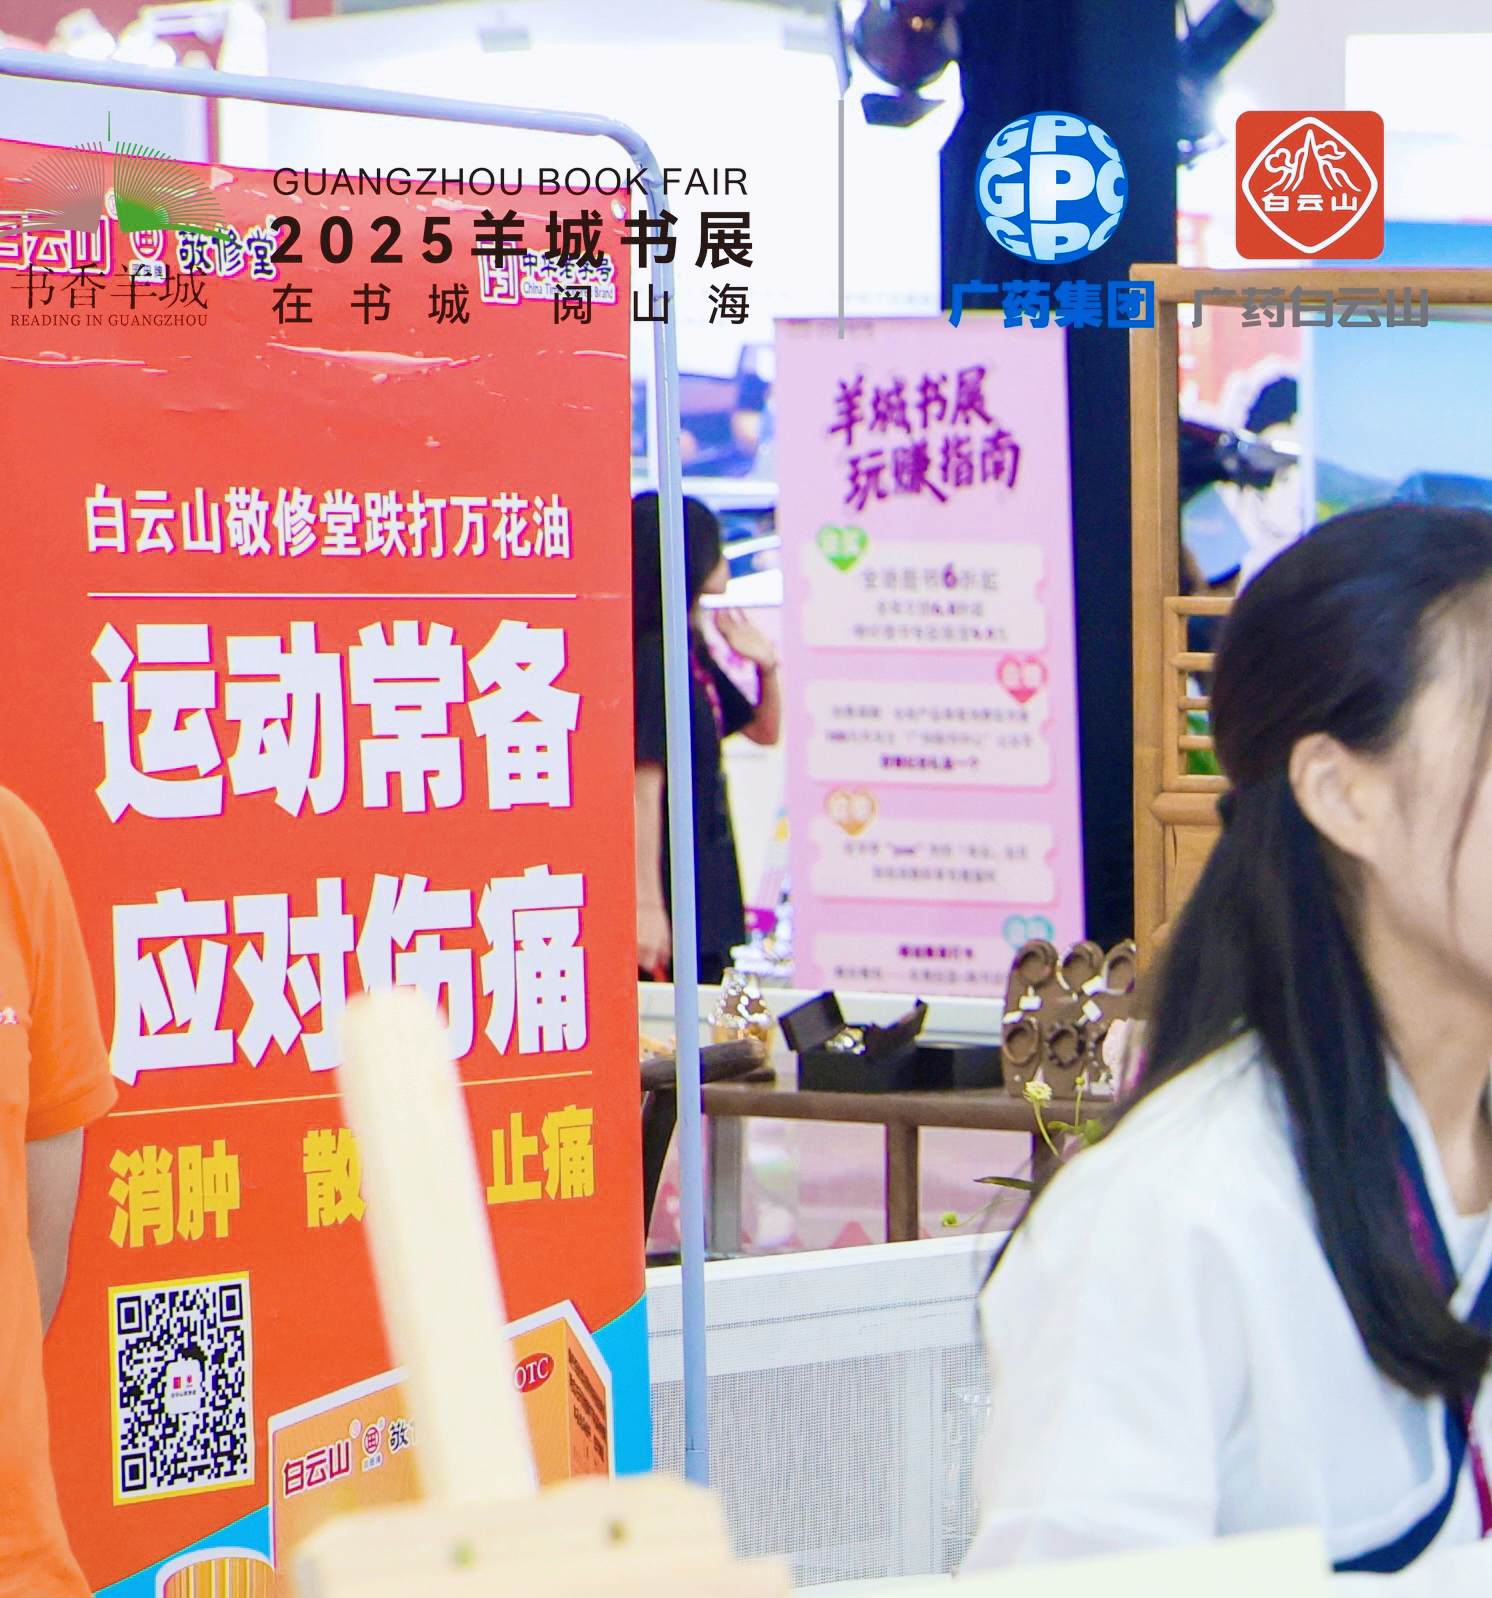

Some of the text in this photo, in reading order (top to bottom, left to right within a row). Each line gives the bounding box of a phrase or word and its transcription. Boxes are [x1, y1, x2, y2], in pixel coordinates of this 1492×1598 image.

[829, 364, 993, 446] 羊城书展
[84, 482, 572, 562] 白云山敬修堂跌打万花油
[90, 618, 581, 824] 运动常备
[109, 864, 590, 1087] 应对伤痛
[108, 1138, 241, 1248] 消肿
[486, 1103, 595, 1206] 止痛
[514, 1355, 550, 1390] OTC
[282, 1440, 350, 1497] 白云山
